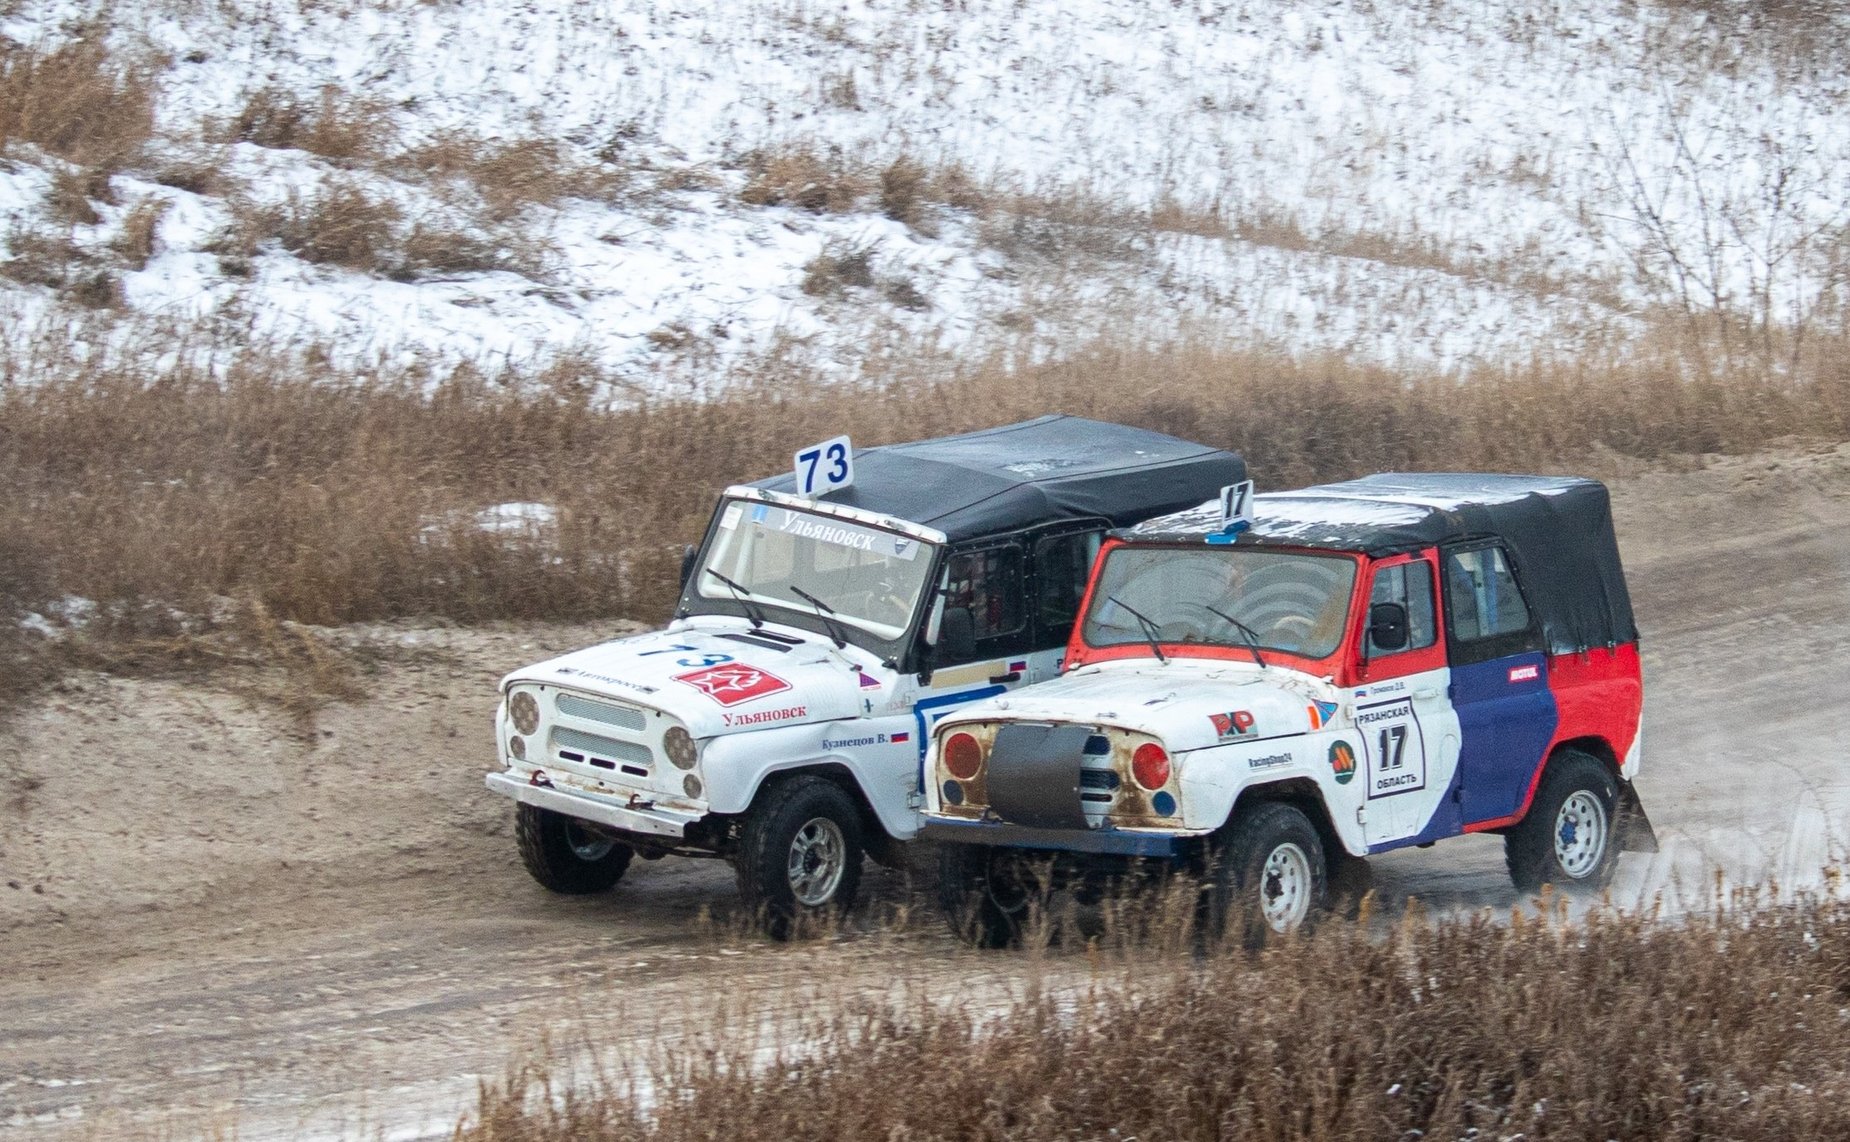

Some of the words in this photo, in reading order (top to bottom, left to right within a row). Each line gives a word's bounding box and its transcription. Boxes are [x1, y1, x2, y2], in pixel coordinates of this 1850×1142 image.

[799, 443, 849, 494] 73
[1224, 482, 1249, 521] 17
[779, 510, 877, 550] Ульяновск
[638, 645, 735, 667] 73
[1510, 666, 1538, 681] MOTUL
[722, 705, 808, 728] Ульяновск
[1358, 706, 1410, 724] РЯЗАНСКАЯ
[821, 738, 875, 751] Кузнецов
[877, 733, 889, 744] В.
[1378, 722, 1409, 772] 17
[1247, 752, 1293, 768] RacingShop24
[1376, 774, 1417, 789] ОБЛАСТЬ
